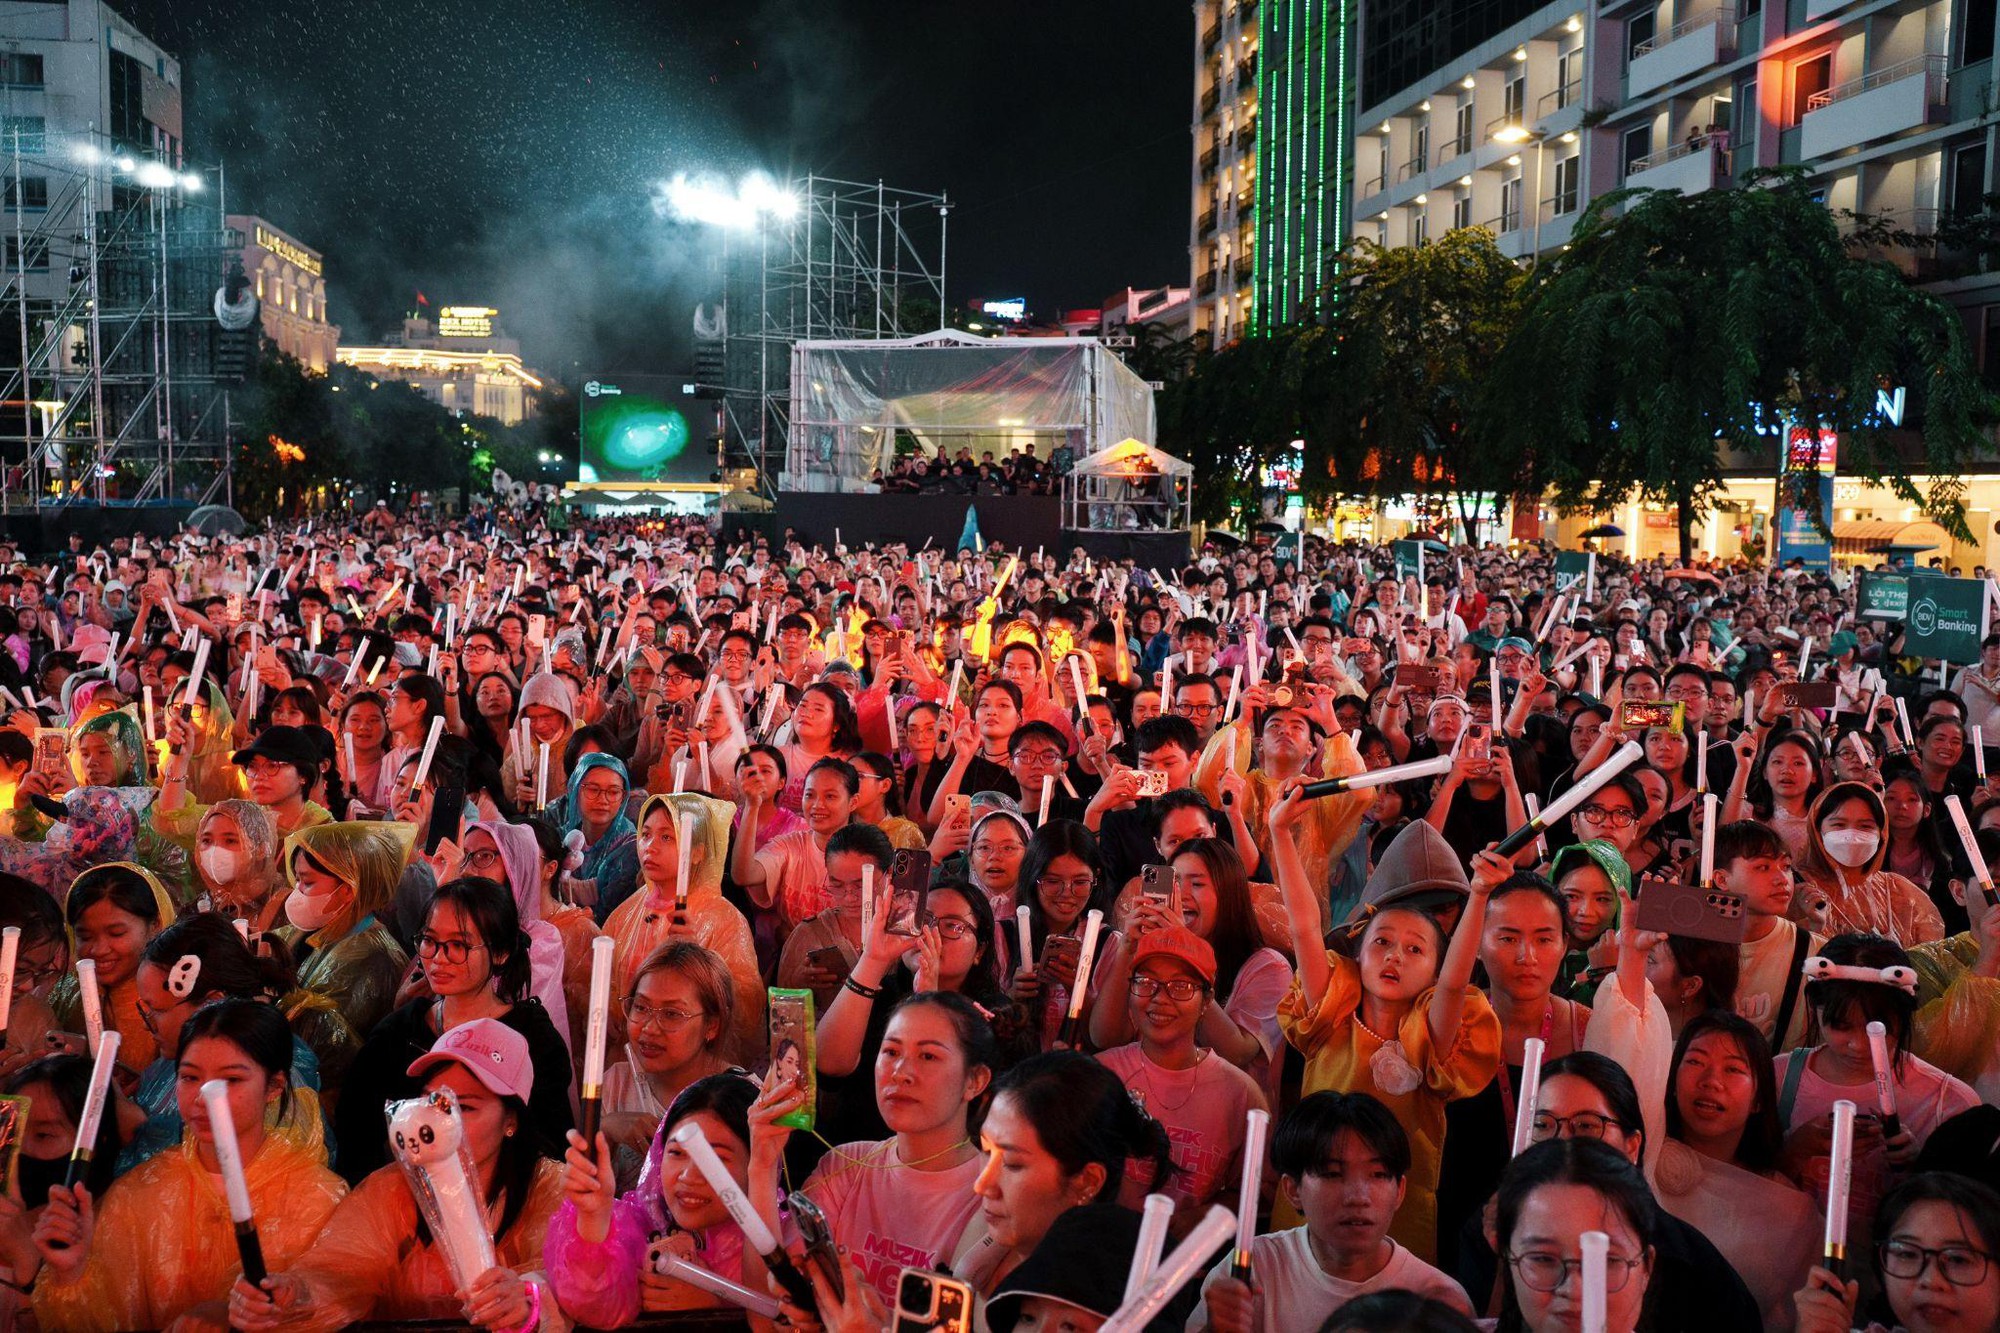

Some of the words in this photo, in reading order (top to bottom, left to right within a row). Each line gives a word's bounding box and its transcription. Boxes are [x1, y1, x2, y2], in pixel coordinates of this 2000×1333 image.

[1276, 547, 1291, 559] BIDV
[1917, 612, 1932, 622] BIDV
[1938, 607, 1969, 619] Smart
[1937, 619, 1977, 635] Banking
[1165, 1125, 1206, 1148] ZIK
[863, 1230, 937, 1271] MUZIK
